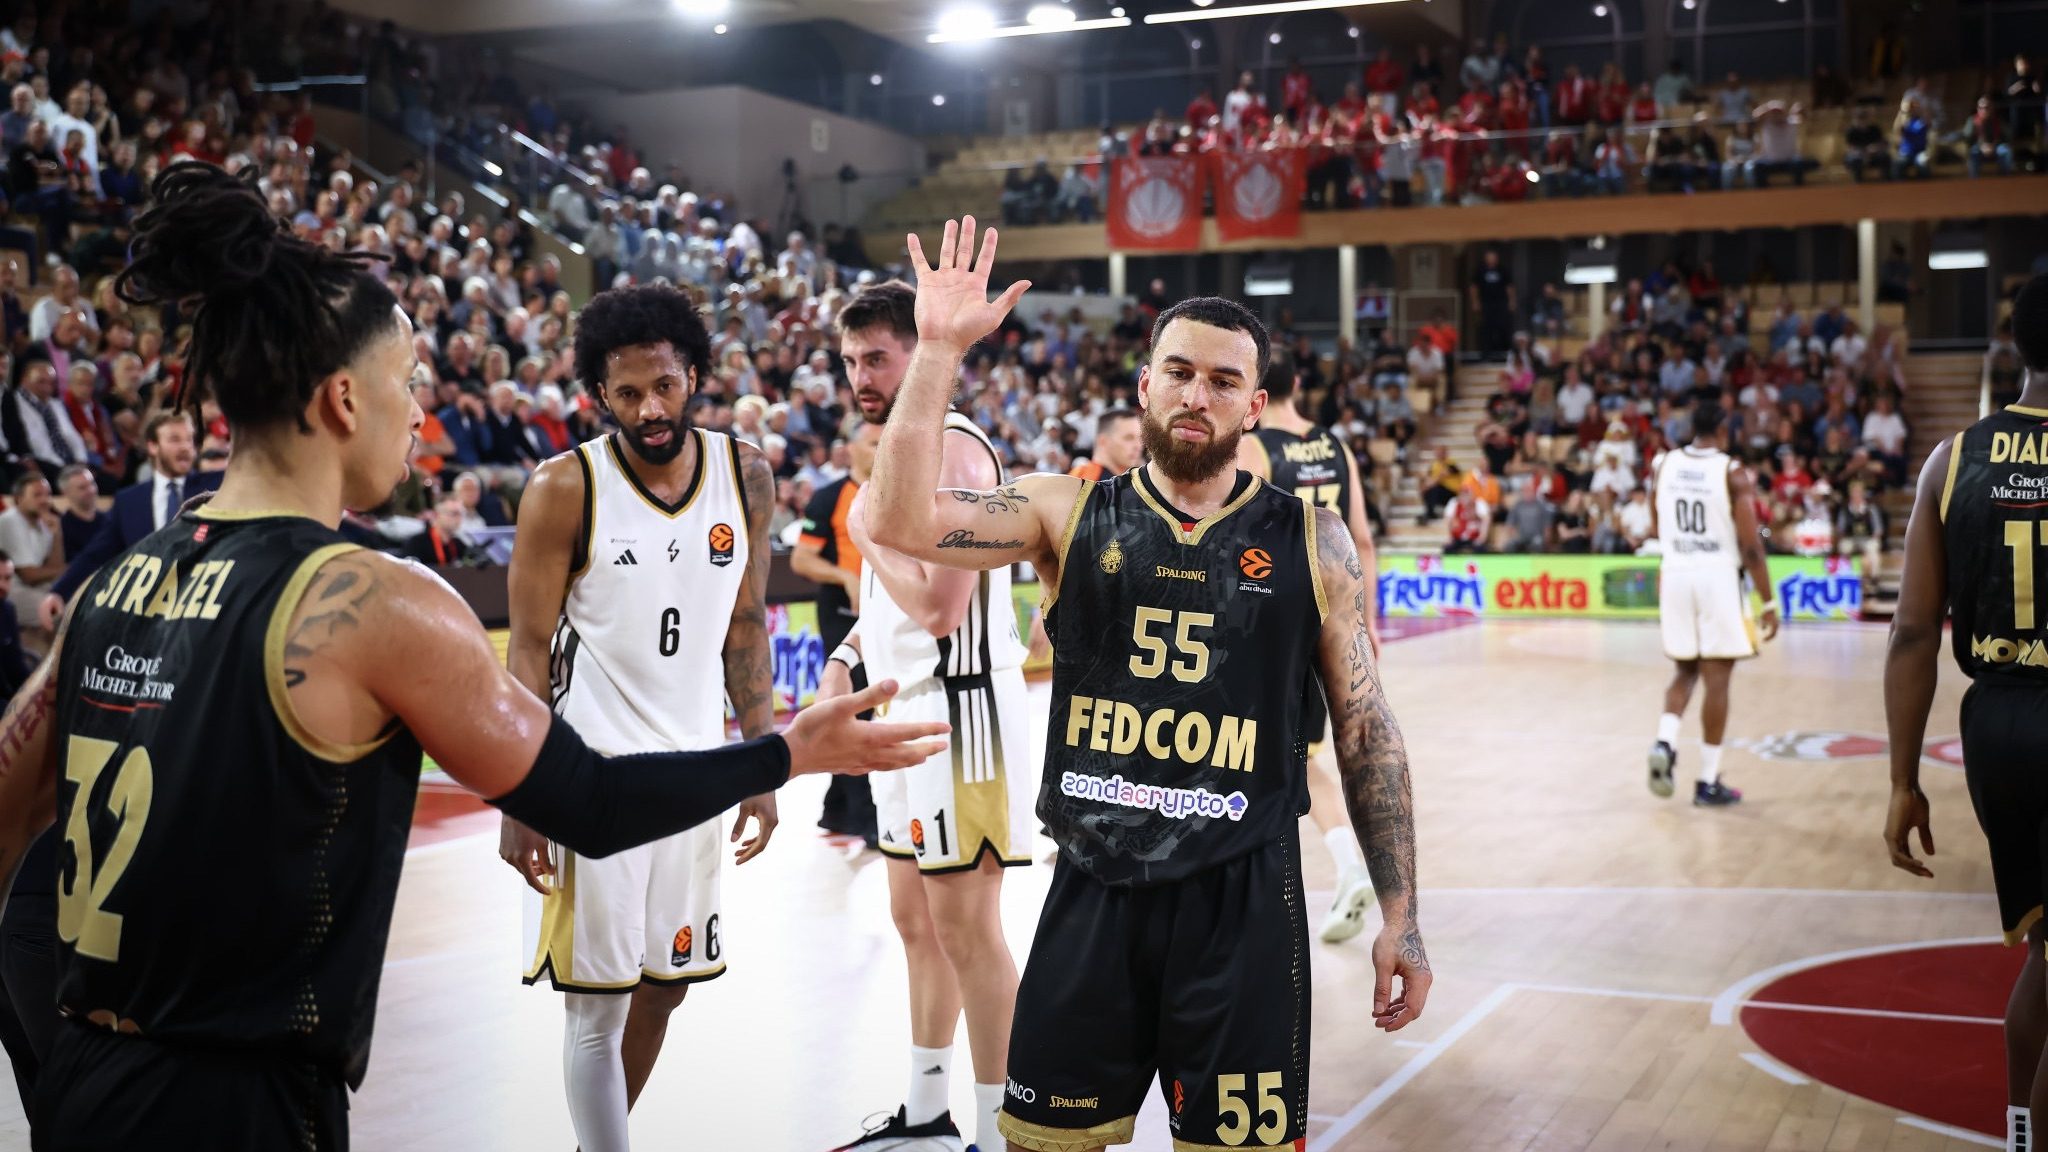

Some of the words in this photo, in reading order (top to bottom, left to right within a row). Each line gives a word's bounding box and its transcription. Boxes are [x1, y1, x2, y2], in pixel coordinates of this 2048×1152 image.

[1676, 499, 1706, 534] 00
[95, 553, 236, 621] STRAZEL
[1155, 565, 1206, 583] SPALDING
[1495, 572, 1588, 610] extra
[2004, 520, 2048, 630] 1
[659, 607, 679, 657] 6
[1129, 606, 1214, 684] 55
[80, 666, 138, 698] MICHEL
[1066, 695, 1257, 773] FEDCOM
[57, 734, 153, 963] 32
[934, 808, 949, 856] 1
[1049, 1096, 1099, 1108] SPALDING
[1215, 1071, 1288, 1146] 55
